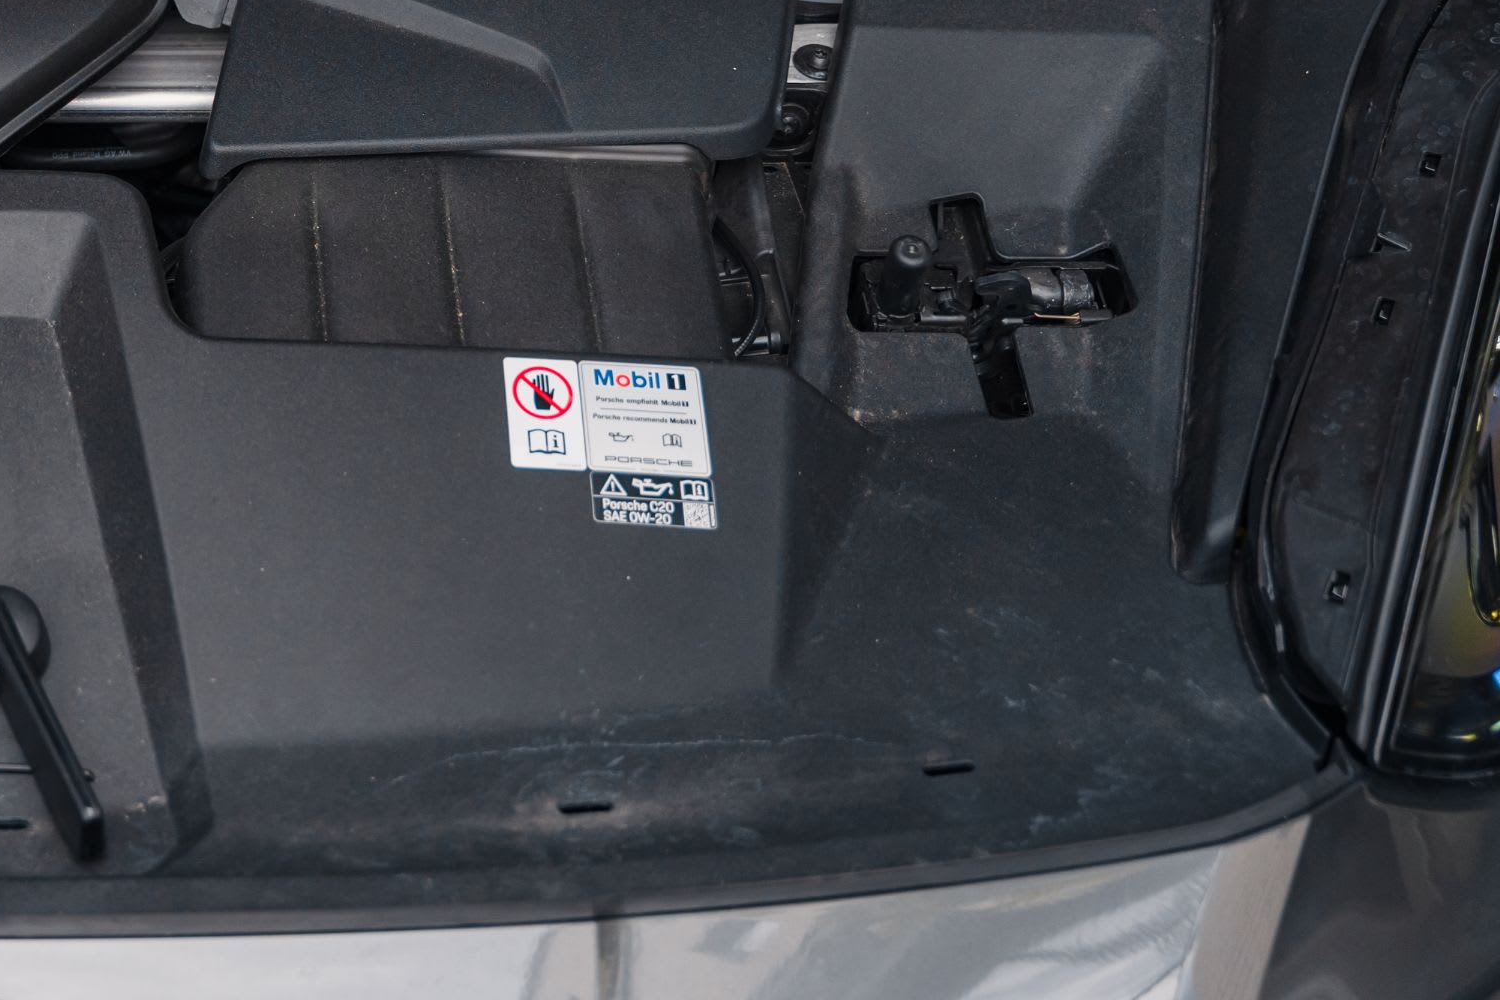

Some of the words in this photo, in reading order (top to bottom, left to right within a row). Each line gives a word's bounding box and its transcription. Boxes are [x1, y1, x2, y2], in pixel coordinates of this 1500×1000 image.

[593, 369, 661, 389] Mobil
[595, 395, 624, 403] Porsche
[592, 412, 621, 420] Porsche
[622, 415, 668, 423] recommends
[604, 455, 693, 467] PORSCHE
[602, 498, 648, 511] Porsche
[649, 501, 675, 513] C20
[603, 510, 627, 521] SAE
